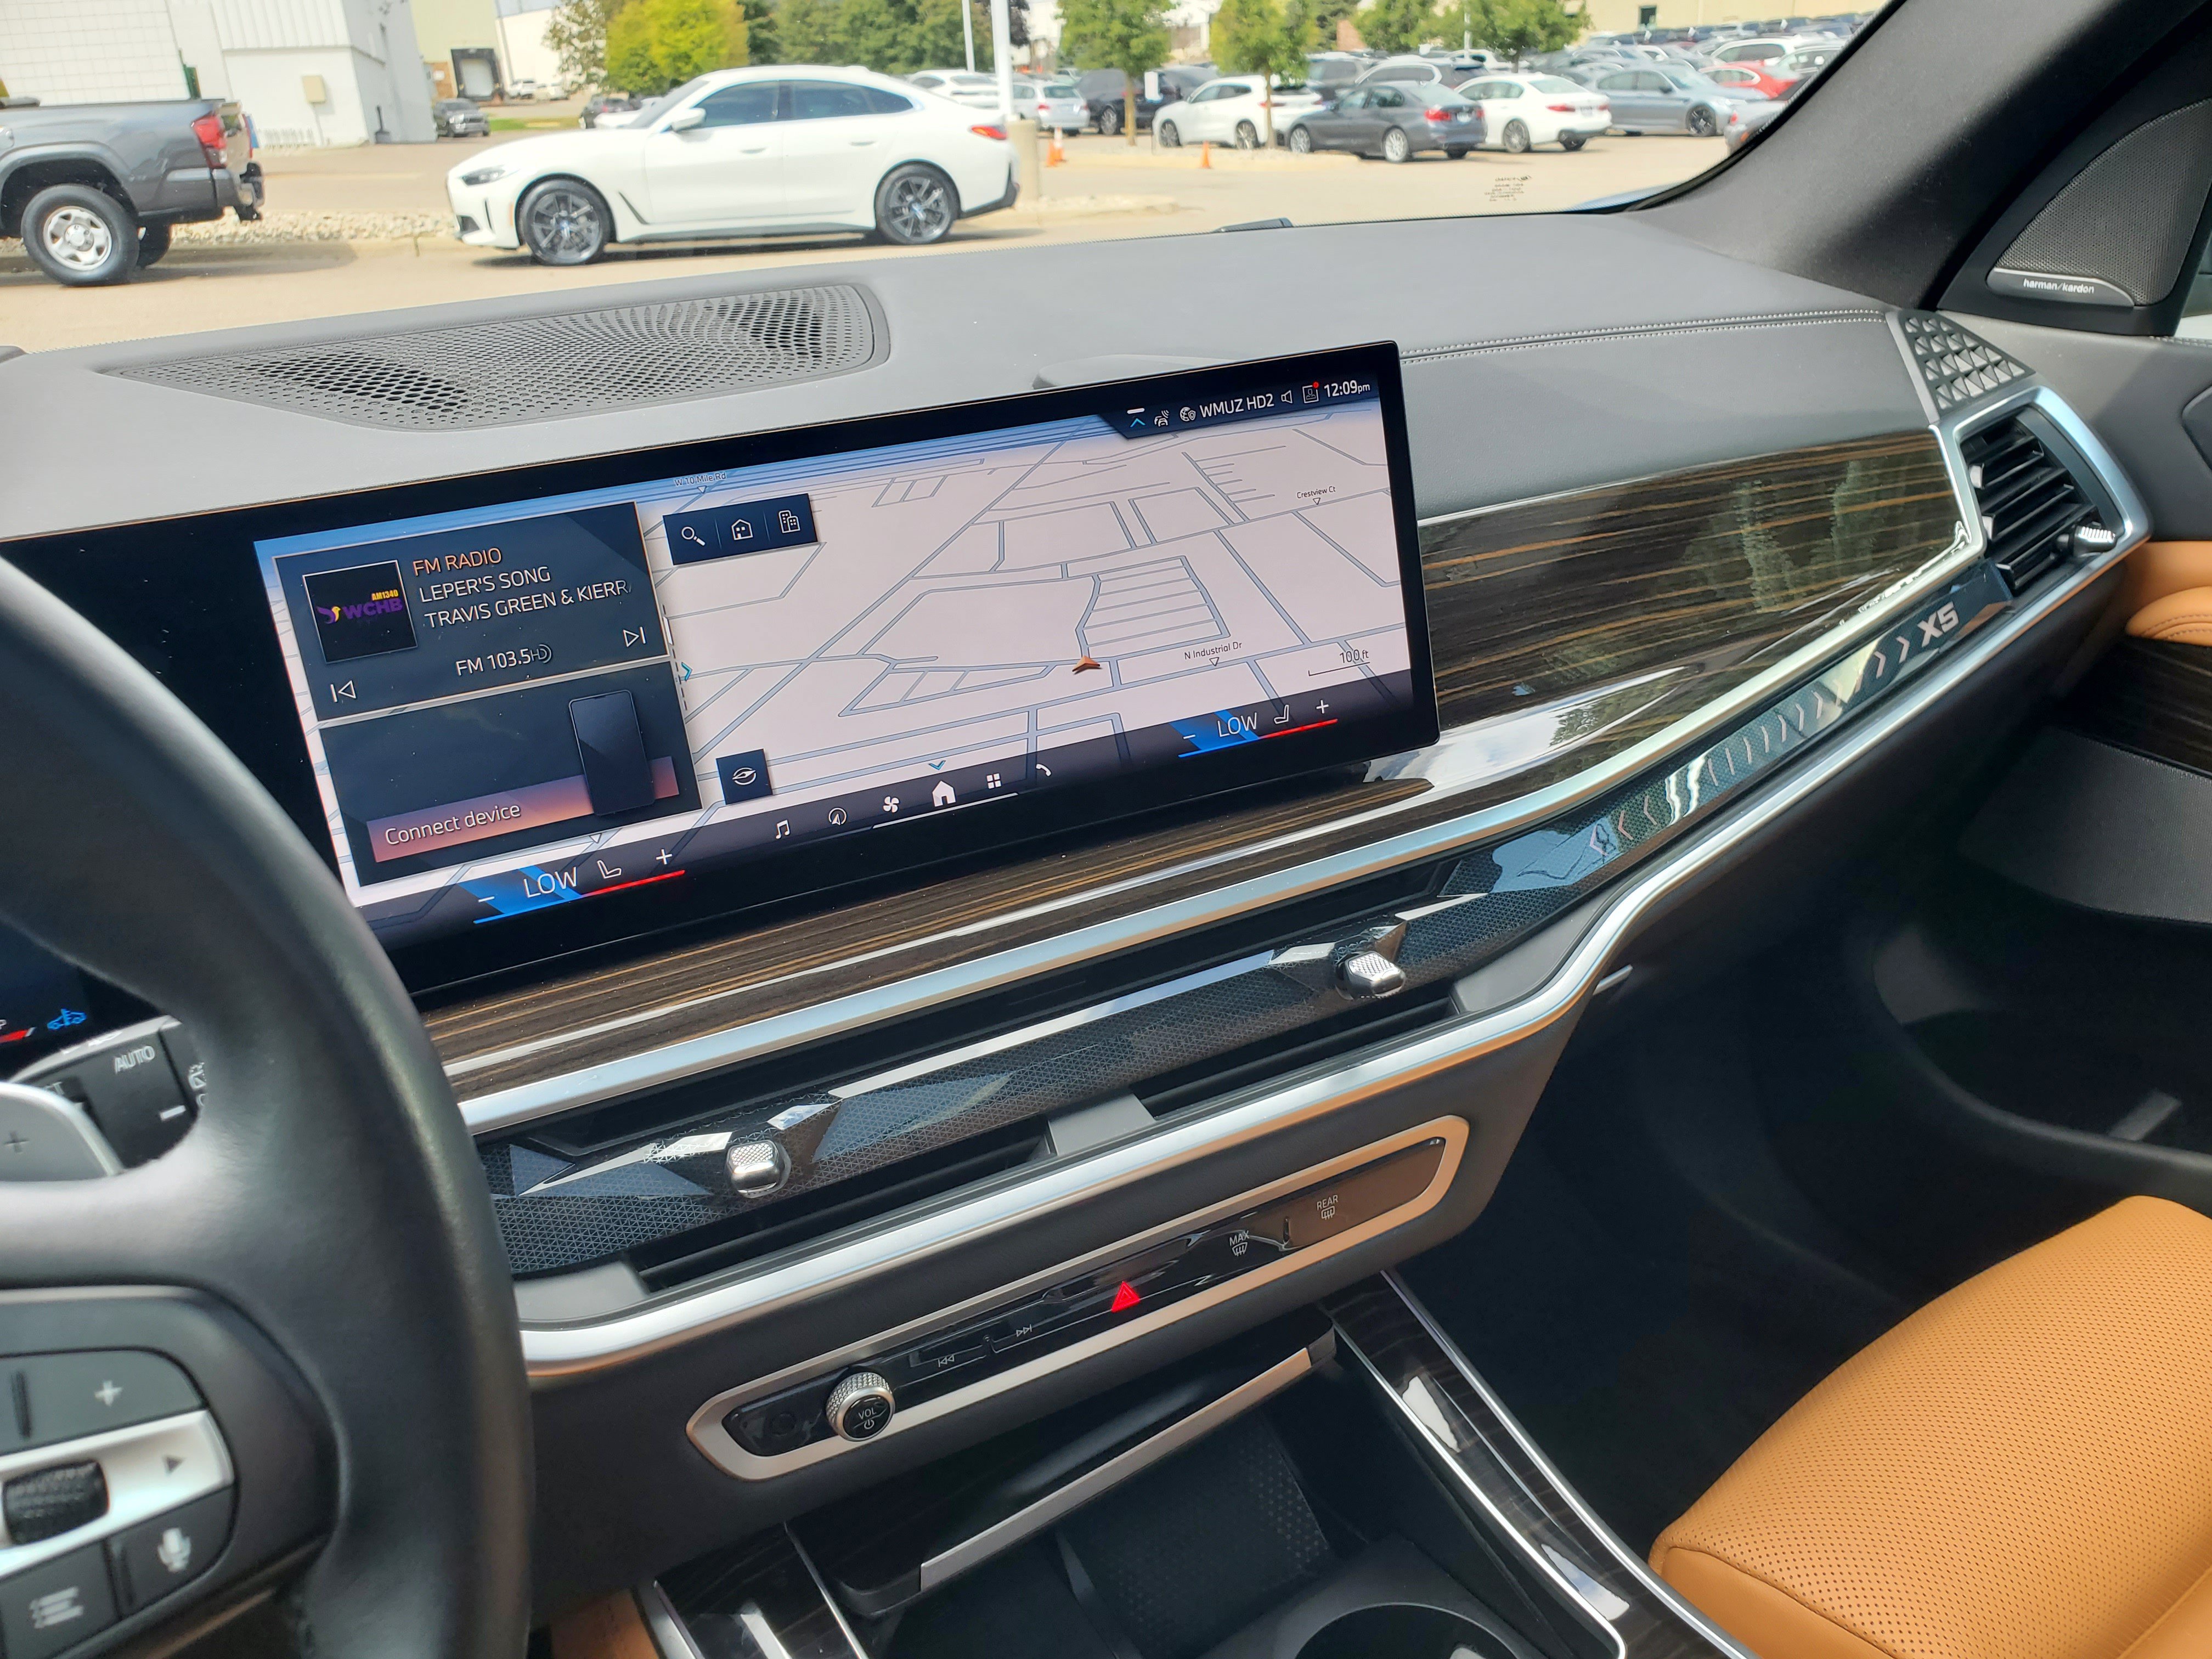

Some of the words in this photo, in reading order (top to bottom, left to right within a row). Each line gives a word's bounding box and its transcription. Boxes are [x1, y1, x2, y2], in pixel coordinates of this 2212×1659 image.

[2023, 278, 2095, 294] harman/kardon
[1324, 380, 1370, 398] 12:09pm
[1199, 399, 1244, 418] WMUZ
[1246, 393, 1274, 410] HD2
[697, 475, 713, 483] Mile
[1296, 489, 1327, 499] Crestview
[413, 557, 441, 576] FM
[444, 548, 502, 571] RADIO
[419, 575, 495, 603] LEPER'S
[499, 566, 551, 589] SONG
[371, 589, 399, 601] AM1340
[424, 603, 492, 628] TRAVIS
[495, 591, 557, 617] GREEN
[560, 589, 574, 605] &
[577, 580, 632, 602] KIERR
[342, 598, 404, 619] WCHB
[1917, 601, 1959, 648] X5
[1184, 651, 1191, 660] N
[1193, 643, 1231, 658] Industrial
[1233, 641, 1242, 650] Dr
[1339, 649, 1360, 664] 100
[1362, 649, 1369, 659] ft
[455, 657, 484, 676] FM
[1217, 712, 1257, 737] LOW
[385, 816, 461, 845] Connect
[464, 804, 521, 828] device
[523, 866, 577, 898] LOW
[114, 1045, 156, 1074] AUTO
[1317, 1194, 1339, 1211] REAR
[1229, 1229, 1250, 1246] MAX
[858, 1407, 877, 1420] VOL
